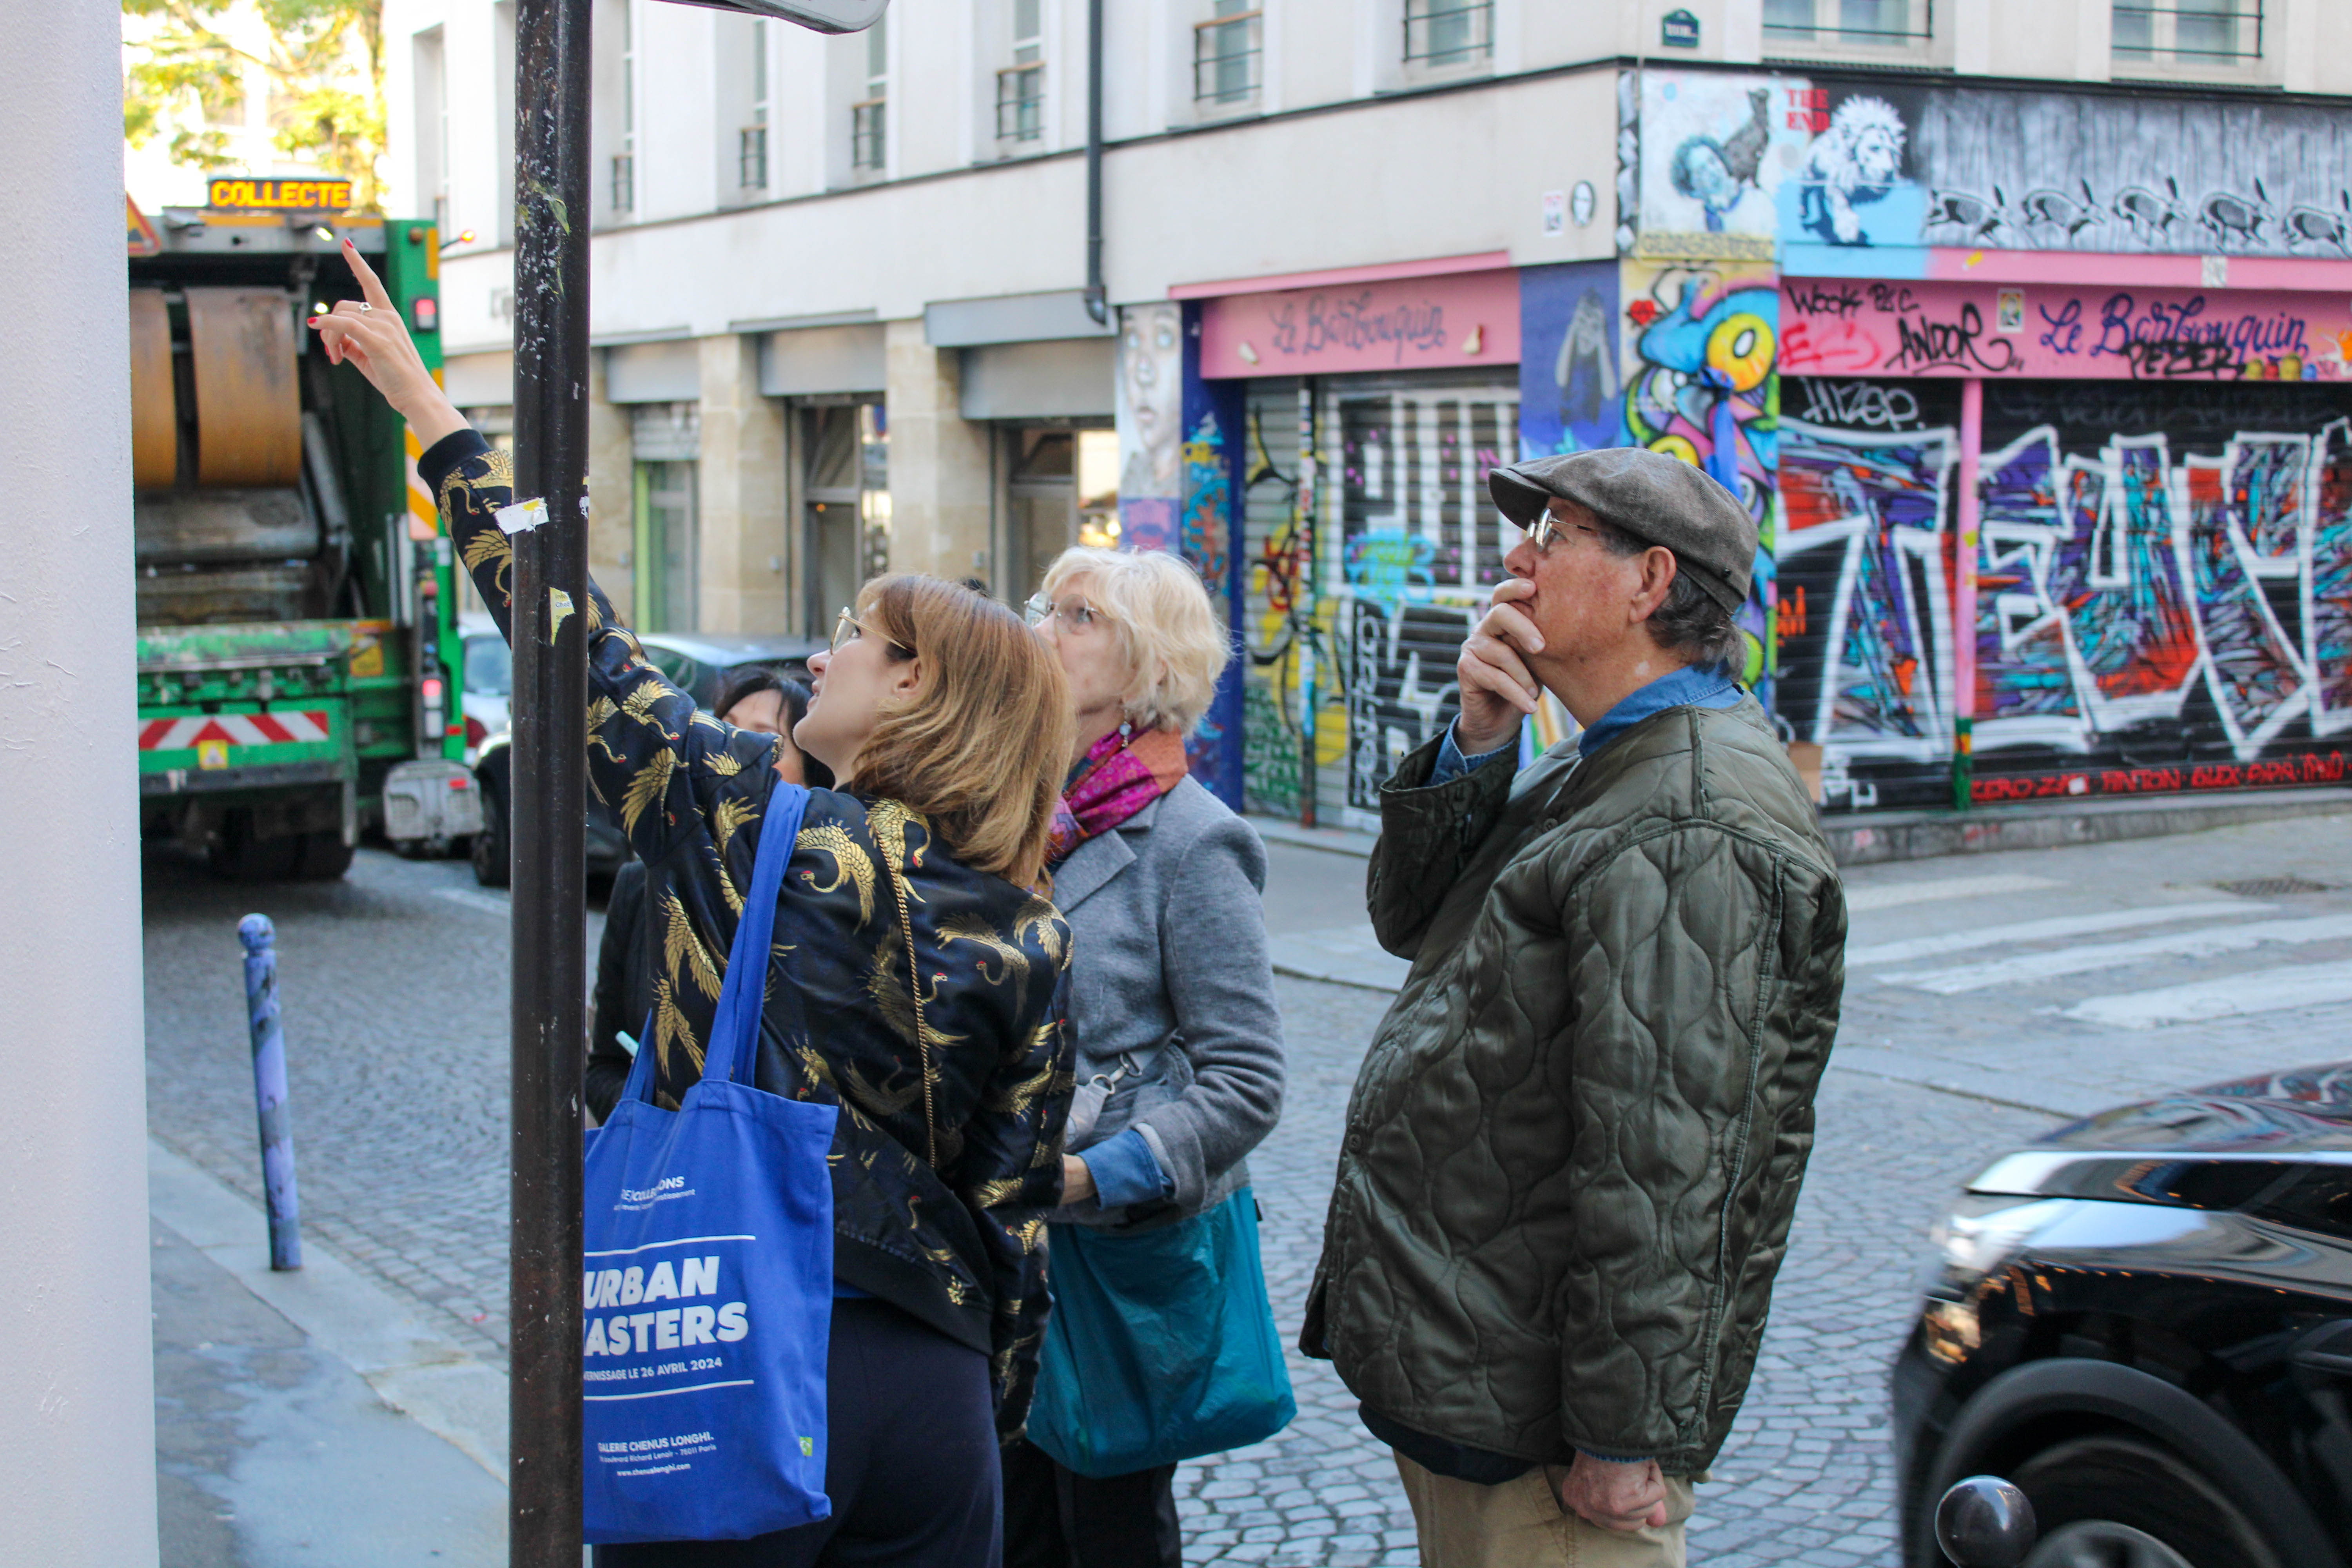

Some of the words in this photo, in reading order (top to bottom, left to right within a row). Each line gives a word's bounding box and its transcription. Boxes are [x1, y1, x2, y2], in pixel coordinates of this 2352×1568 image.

[1785, 89, 1828, 108] THE
[1787, 111, 1830, 132] END
[212, 181, 350, 207] COLLECTE
[2040, 299, 2082, 354] Le
[584, 1256, 720, 1309] URBAN
[584, 1301, 749, 1356] ASTERS
[628, 1368, 639, 1379] LE
[640, 1367, 655, 1377] 26
[657, 1361, 688, 1376] AVRIL
[690, 1356, 723, 1371] 2024
[629, 1437, 670, 1452] CHENUS
